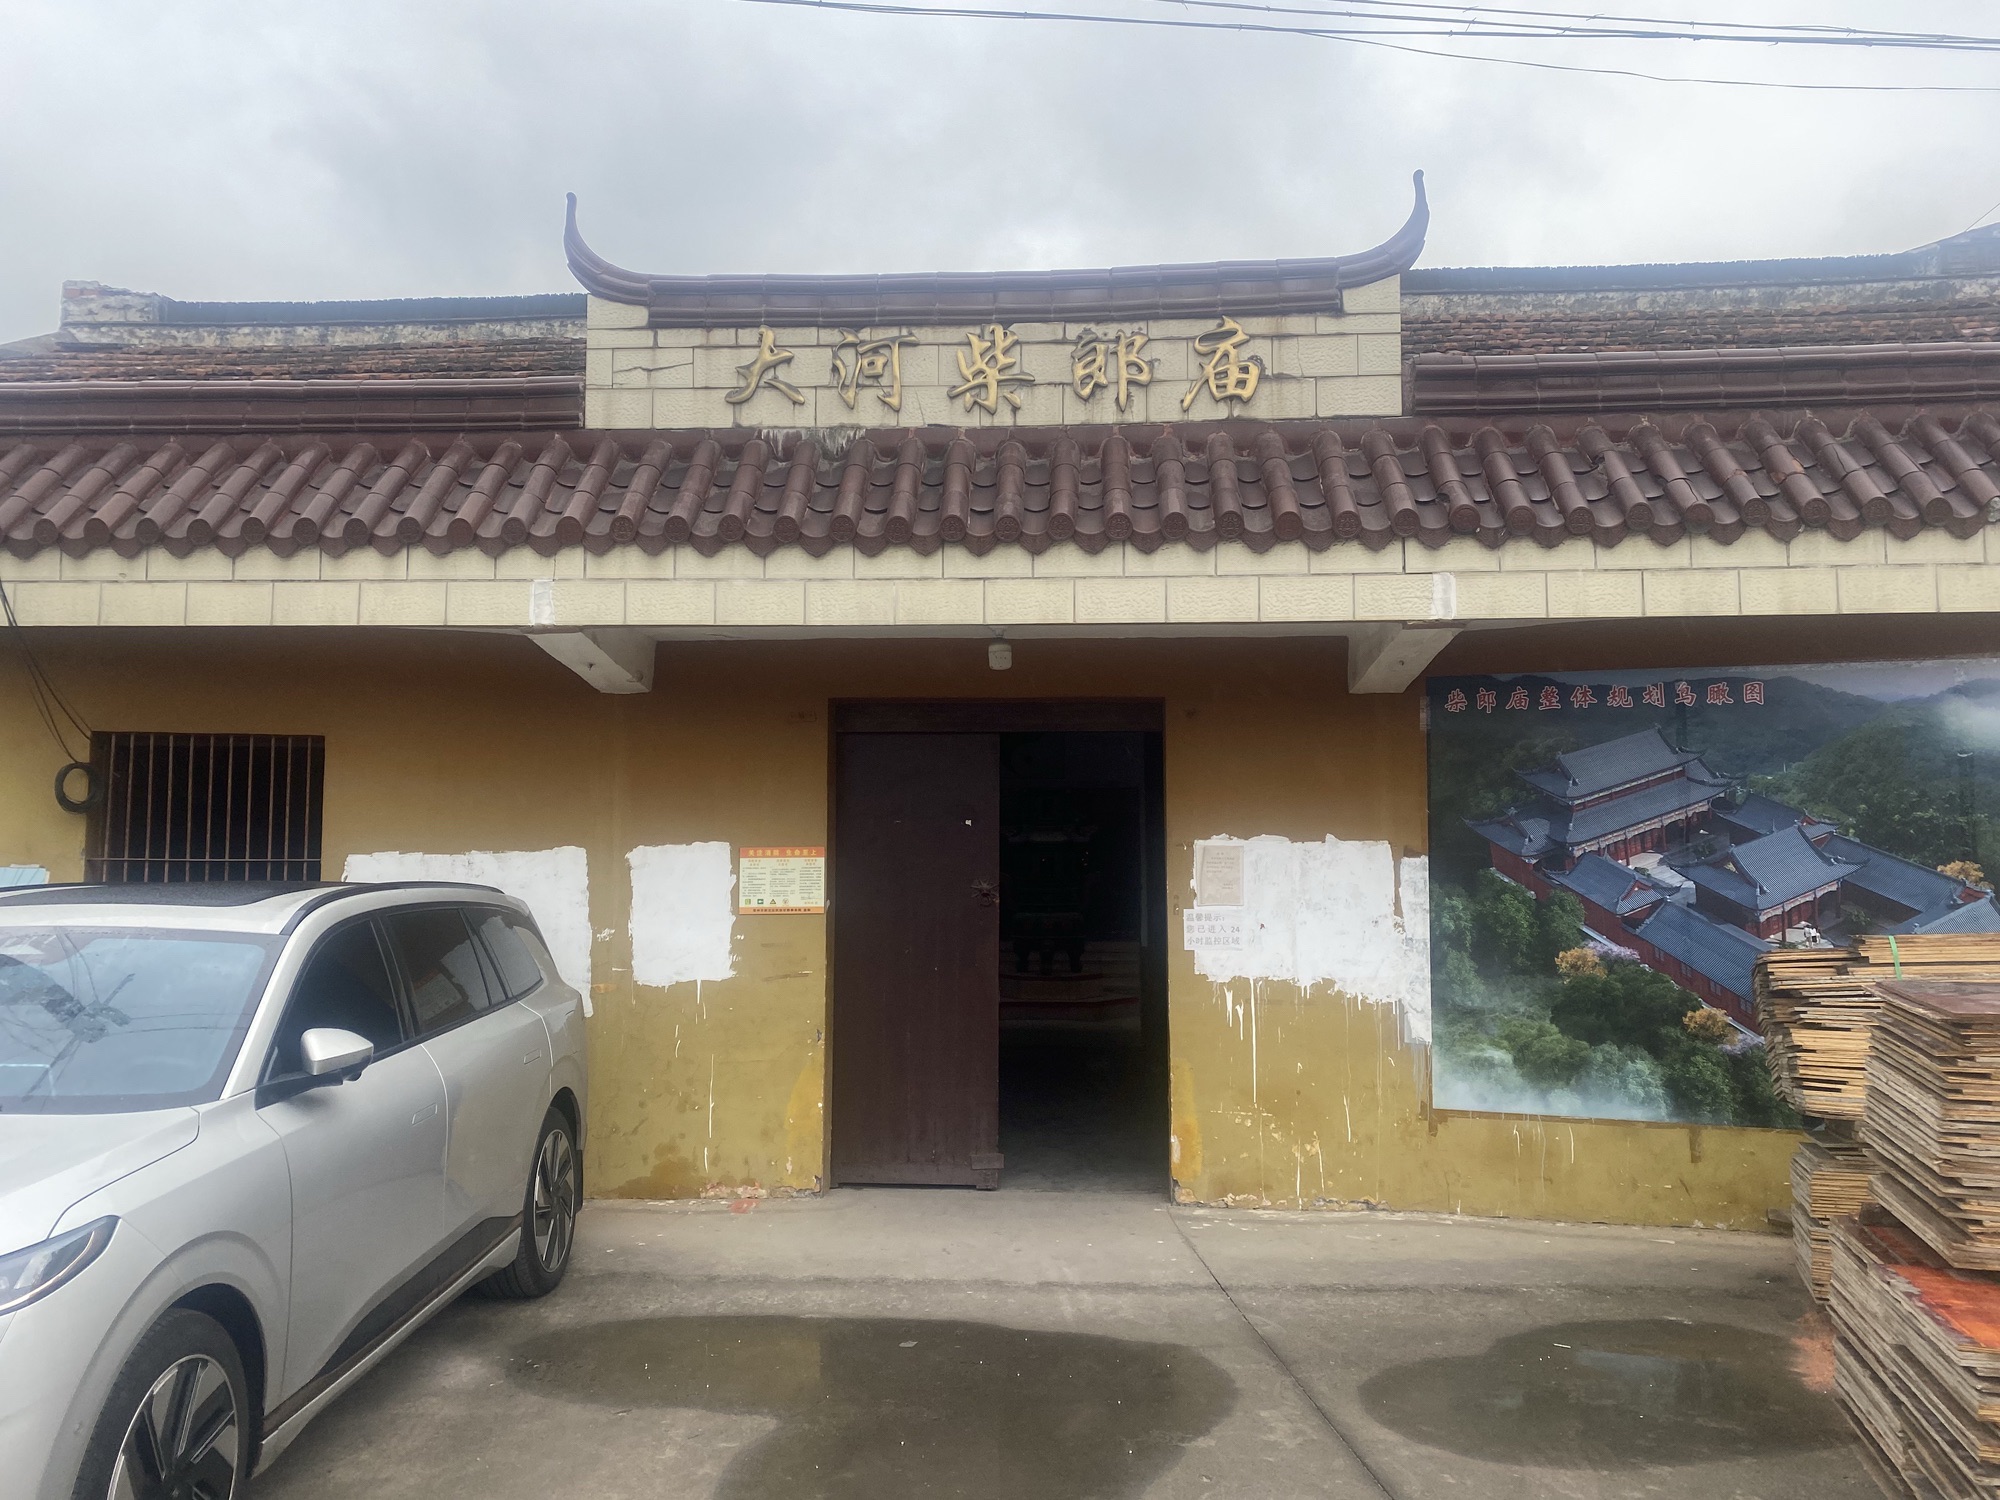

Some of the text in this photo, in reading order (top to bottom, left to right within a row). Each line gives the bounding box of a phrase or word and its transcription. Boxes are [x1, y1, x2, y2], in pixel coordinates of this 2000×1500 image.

[724, 315, 1261, 414] 大河柴郎庙
[1444, 682, 1765, 713] 柴郎庙整体规划鸟瞰图
[1187, 936, 1240, 946] 小时监控区域
